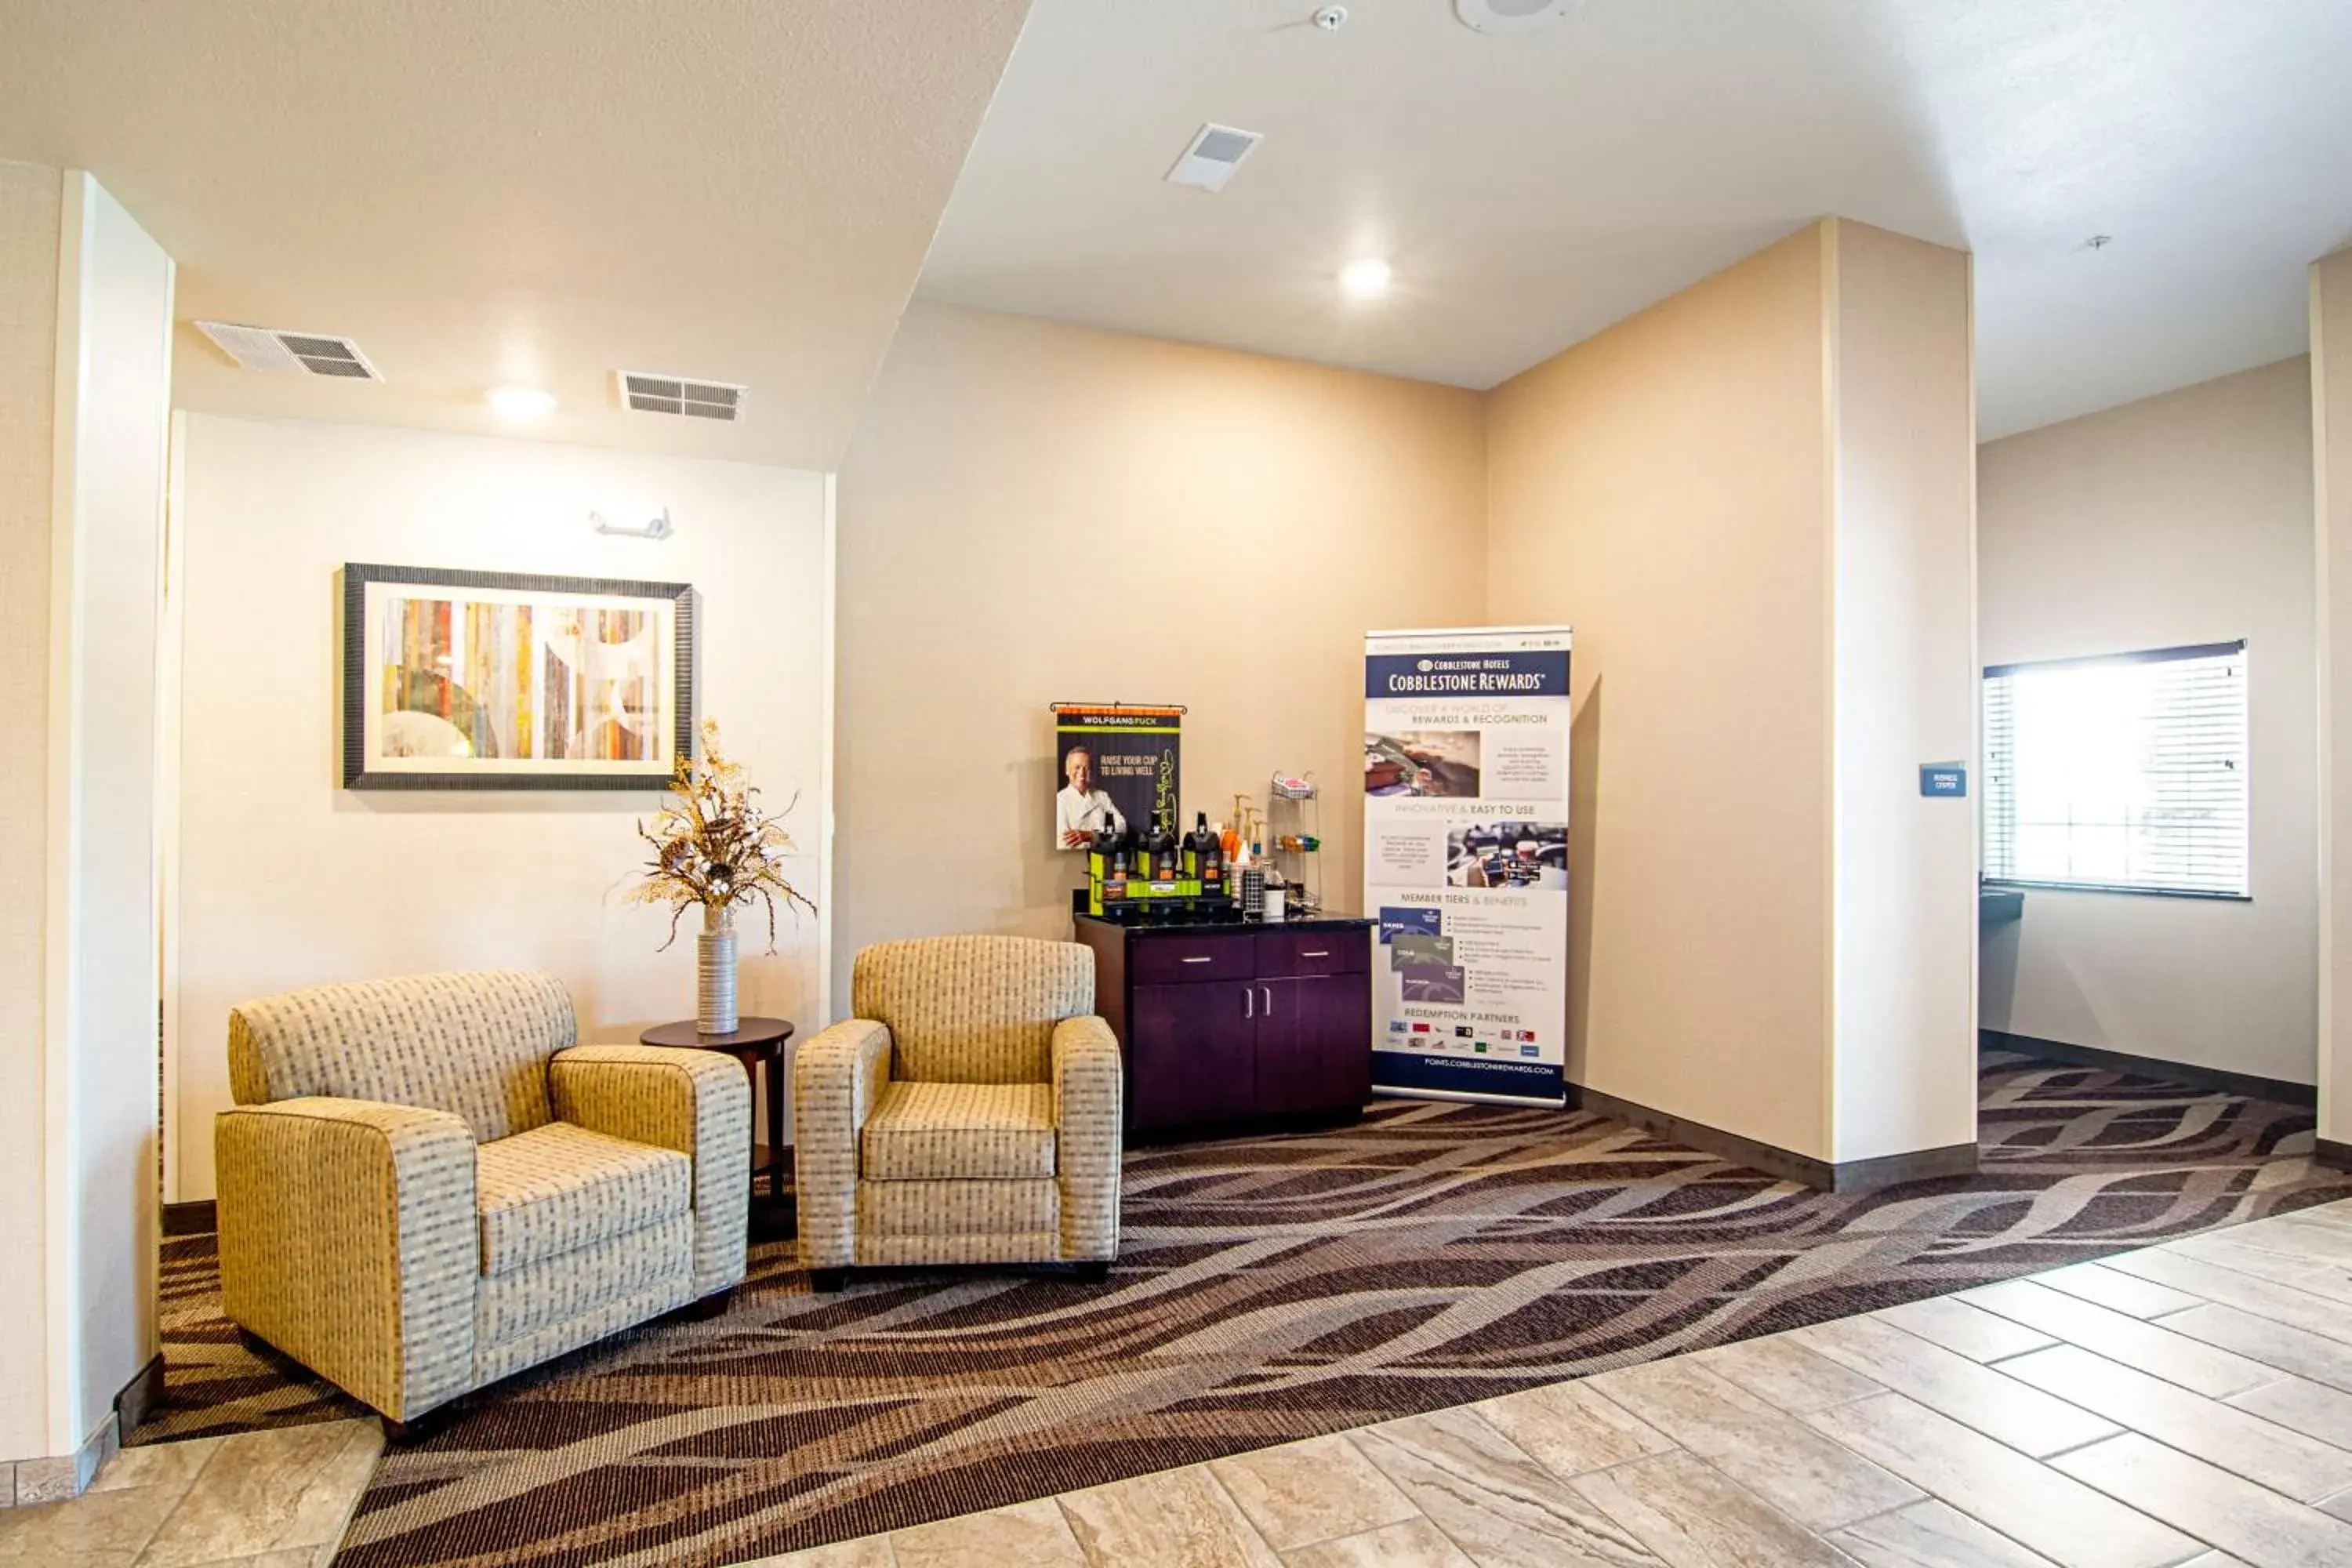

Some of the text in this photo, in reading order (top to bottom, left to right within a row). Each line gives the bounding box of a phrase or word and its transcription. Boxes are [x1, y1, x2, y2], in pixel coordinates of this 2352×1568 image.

[1388, 674, 1477, 691] COBBLESTONE
[1412, 715, 1459, 724] REWARDS
[1473, 714, 1548, 724] RECOGNITION
[1101, 755, 1158, 766] RAISE YOUR CUP
[1101, 767, 1111, 775] TO
[1134, 767, 1154, 775] WELL
[1394, 804, 1456, 814] INNOVATIVE
[1471, 805, 1497, 815] EASY
[1499, 805, 1514, 815] TO
[1515, 806, 1535, 815] USE
[1401, 894, 1442, 902] MEMBER
[1445, 895, 1470, 904] TIERS
[1484, 897, 1528, 906] BENEFITS
[1404, 1008, 1521, 1024] REDEMPTION PARTNERS
